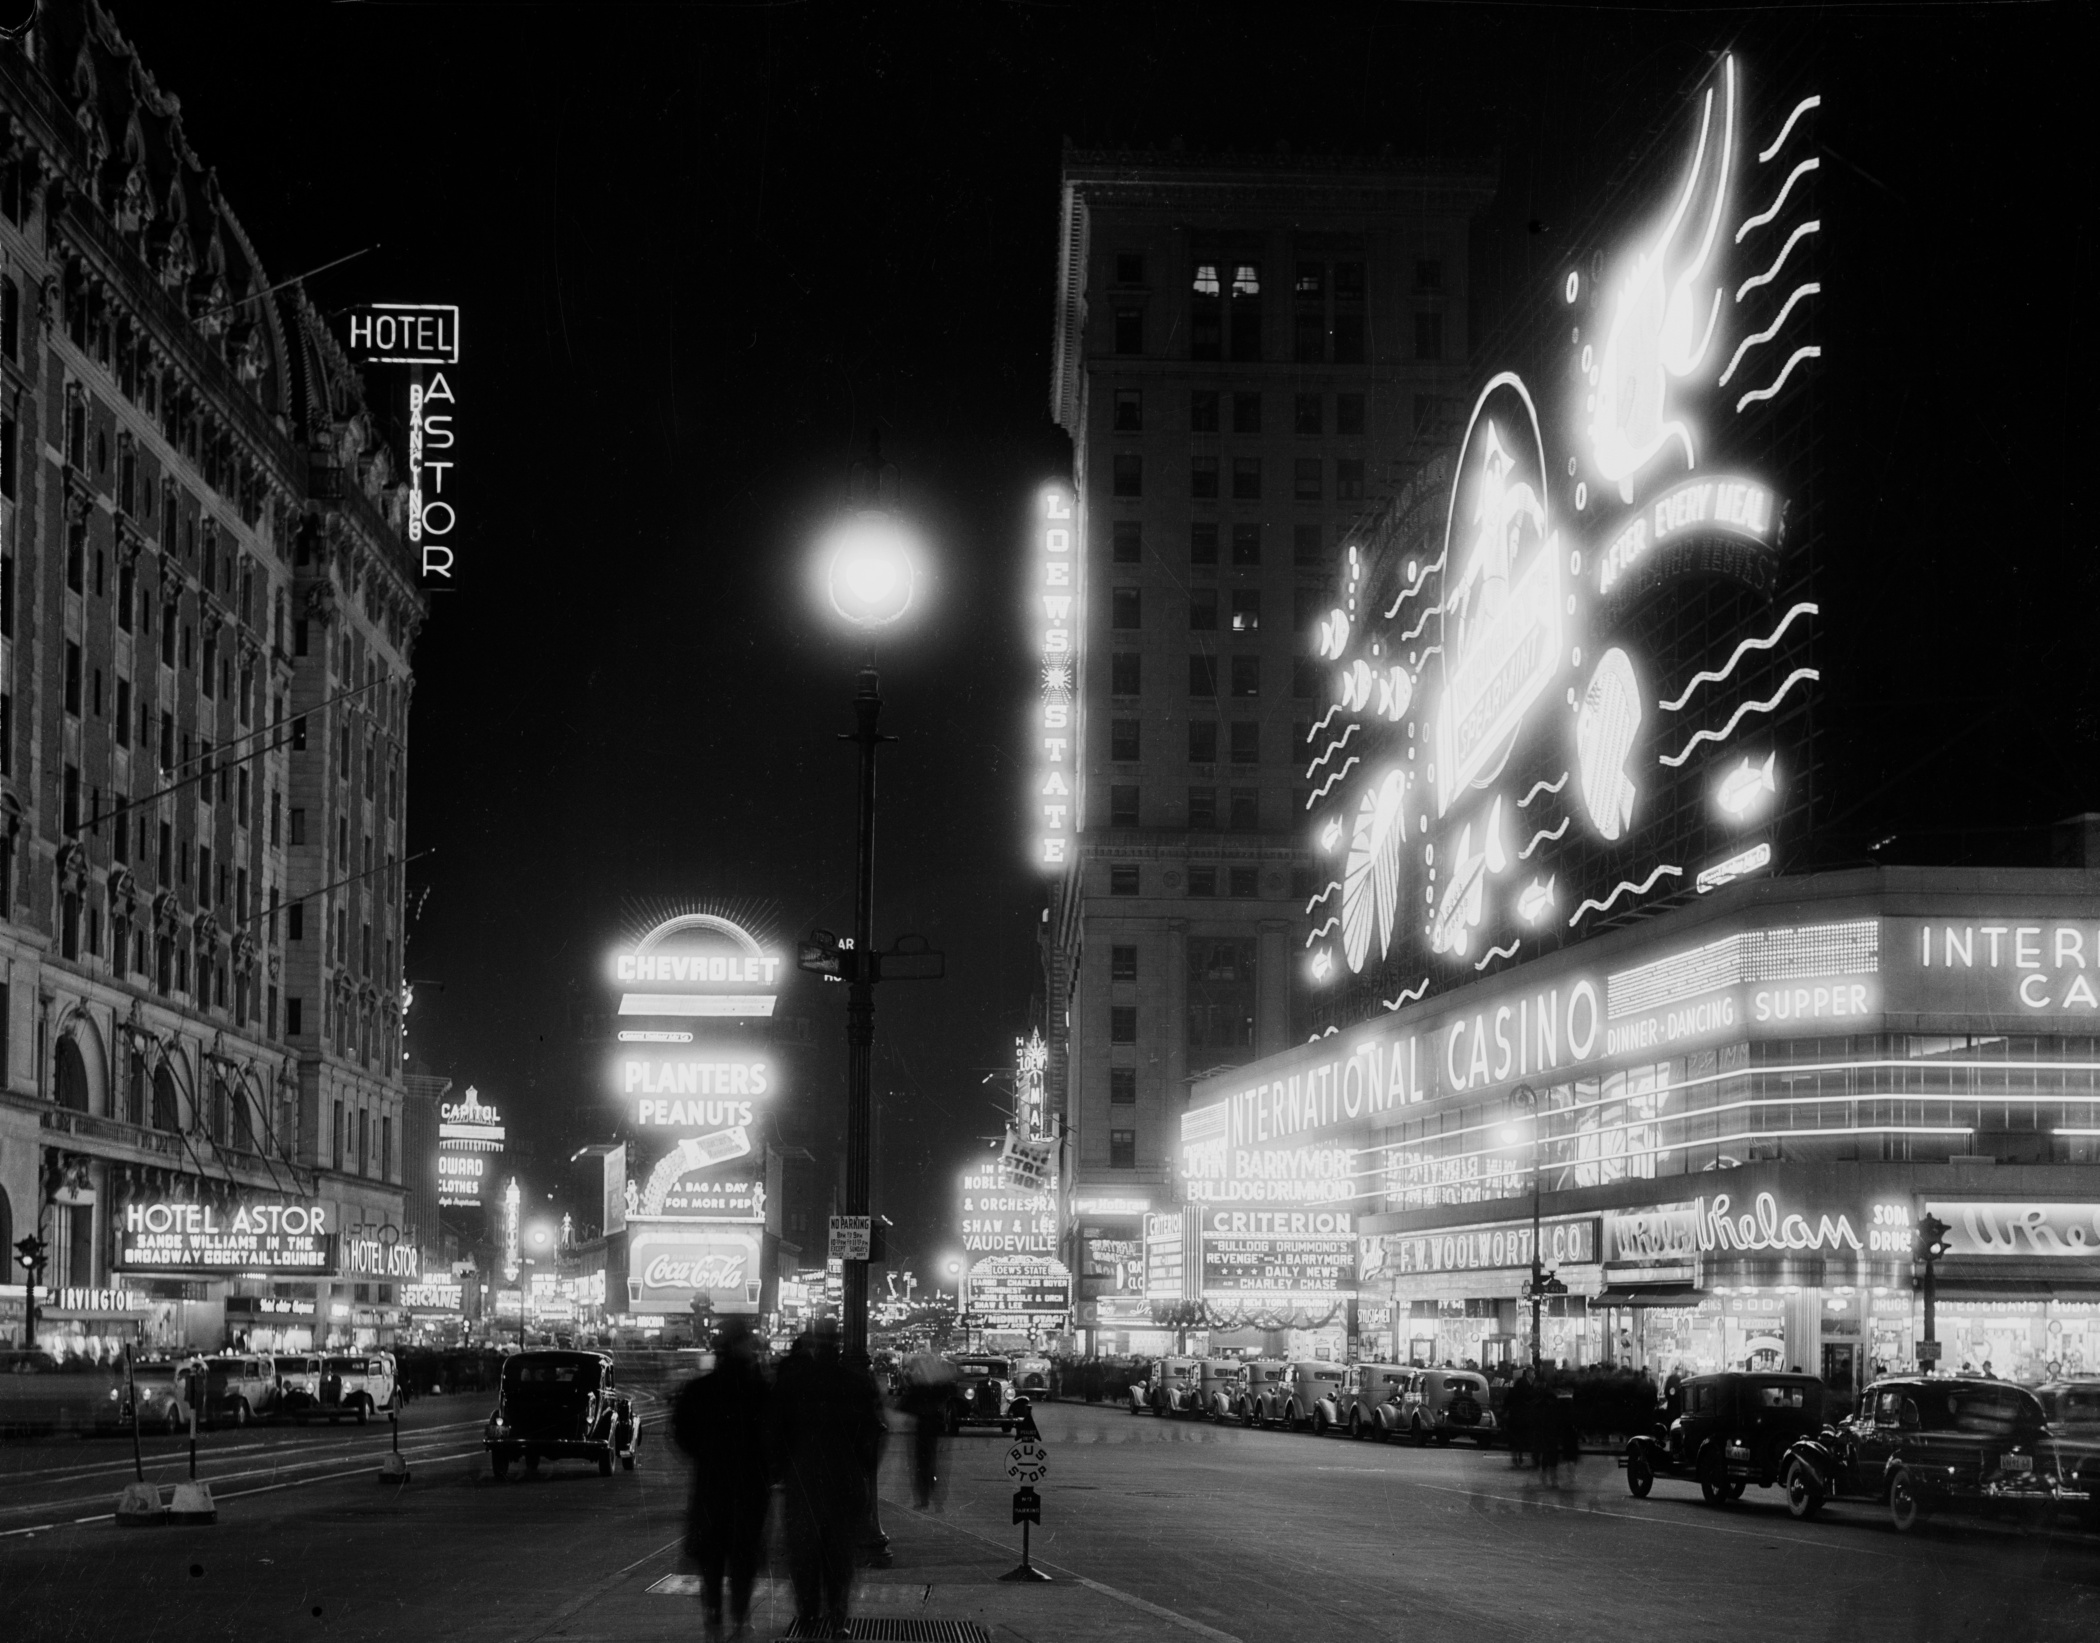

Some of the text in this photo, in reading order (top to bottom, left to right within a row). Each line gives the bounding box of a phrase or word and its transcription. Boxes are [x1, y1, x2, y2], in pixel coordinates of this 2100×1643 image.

[351, 315, 452, 350] HOTEL
[421, 372, 456, 578] ASTOR
[1600, 518, 1647, 594] AFTER
[1655, 483, 1713, 538] EVERY
[1714, 482, 1765, 534] MEAL
[1043, 495, 1072, 652] LOEW'S
[1460, 624, 1541, 760] SPEARMINT
[1043, 704, 1070, 863] STATE
[1923, 926, 2100, 968] INTER
[618, 955, 780, 982] CHEVROLET
[1755, 983, 1868, 1021] SUPPER
[1606, 998, 1734, 1056] DINNER DANCING
[1225, 979, 1598, 1150] INTERNATIONAL CASINO
[625, 1061, 767, 1094] PLANTERS
[441, 1103, 501, 1121] CAPITOL
[639, 1099, 753, 1126] PEANUTS
[438, 1157, 483, 1176] OWARD
[1181, 1148, 1359, 1180] JOHN BARRYMORE
[673, 1182, 748, 1193] A BAG A DAY
[964, 1176, 1005, 1189] NOBLE
[1187, 1179, 1356, 1201] BULLDOG DRUMMOND
[666, 1198, 751, 1209] FOR MORE PEP
[964, 1197, 1057, 1212] & ORCHESTRA
[127, 1203, 325, 1235] HOTEL ASTOR
[831, 1219, 869, 1229] NO PARKING
[1213, 1212, 1351, 1233] CRITERION
[1695, 1192, 1864, 1252] Whelan
[1873, 1204, 1910, 1226] SODA
[962, 1220, 1056, 1233] SHAW & LEE
[1963, 1207, 2100, 1250] Whe
[190, 1235, 258, 1249] WILLIAMS
[266, 1236, 280, 1249] IN
[287, 1236, 314, 1250] THE
[963, 1235, 1057, 1251] VAUDEVILLE
[1212, 1241, 1347, 1252] "BULLDOG DRUMMOND'S
[1552, 1224, 1581, 1262] CO
[1870, 1230, 1912, 1252] DRUGS
[125, 1249, 326, 1266] BROADWAY COCKTAIL LOUNGE
[351, 1239, 417, 1278] HOTEL ASTOR
[1206, 1253, 1264, 1264] REVENGE"
[423, 1273, 451, 1285] HEATRE
[644, 1253, 747, 1289] Coca-Cola
[992, 1266, 1047, 1275] LOEW'S STATE
[1265, 1266, 1339, 1277] DAILY NEWS
[1043, 1279, 1068, 1287] BOYER
[1240, 1278, 1293, 1290] CHARLEY
[1300, 1279, 1337, 1290] CHASE
[60, 1287, 133, 1311] IRVINGTON
[974, 1301, 996, 1309] SHAW
[1008, 1301, 1023, 1309] LEE
[1217, 1298, 1240, 1307] FIRST
[1243, 1298, 1262, 1307] NEW
[1265, 1298, 1289, 1307] YORK
[1732, 1299, 1785, 1311] SODA
[1983, 1301, 2038, 1312] CIGARS
[1011, 1445, 1047, 1461] BUS
[1008, 1465, 1047, 1482] STOP
